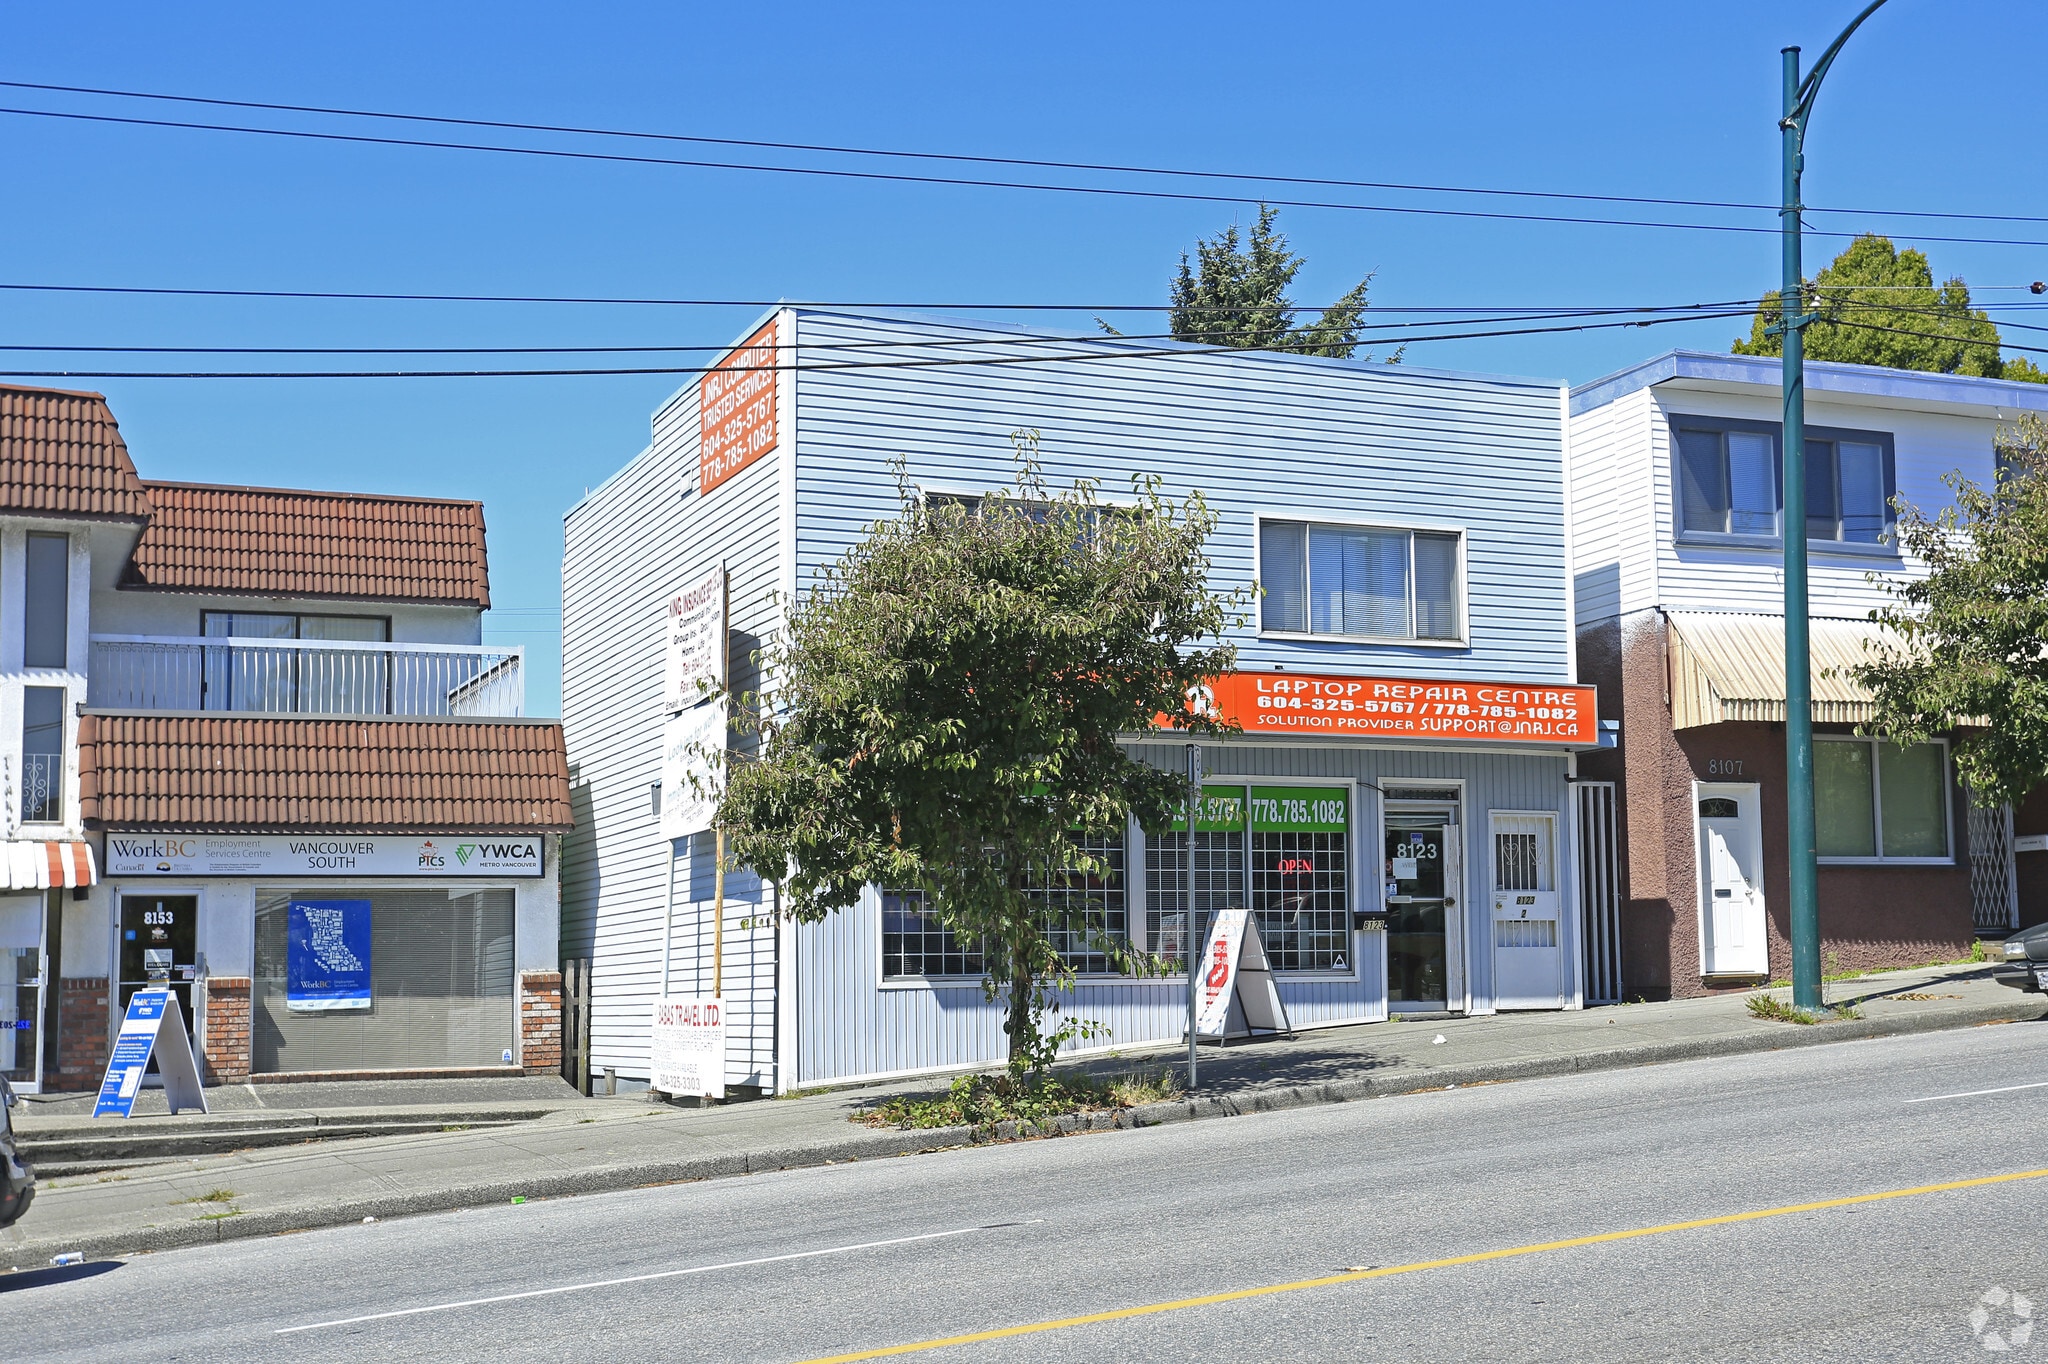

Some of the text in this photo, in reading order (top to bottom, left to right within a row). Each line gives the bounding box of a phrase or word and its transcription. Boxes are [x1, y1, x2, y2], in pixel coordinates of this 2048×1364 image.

[703, 332, 773, 408] JNRJ COMPUTER
[703, 361, 772, 432] TRUSTED SERVICES
[703, 391, 772, 460] 604-325-5767
[703, 420, 773, 486] 778-785-1082
[1257, 679, 1577, 706] LAPTOP REPAIR CENTRE
[1257, 696, 1415, 714] 604-325-5767
[1432, 703, 1578, 720] 778-785-1082
[1257, 714, 1578, 736] SOLUTION PROVIDER SUPPORT@JNRJ.CA
[1709, 759, 1743, 775] 8107
[1252, 799, 1345, 824] 778.785.1082
[112, 839, 196, 858] WorkBC
[205, 839, 261, 849] Employment
[289, 842, 374, 854] VANCOUVER
[478, 844, 536, 858] YWCA
[1397, 843, 1437, 859] 8123
[205, 849, 271, 858] Services Centre
[419, 856, 445, 867] PICS
[308, 856, 356, 868] SOUTH
[1278, 859, 1312, 875] OPEN
[1516, 896, 1536, 905] 8123
[144, 911, 174, 924] 8153
[1363, 921, 1385, 930] 8123
[300, 980, 331, 989] WorkBC
[675, 1004, 701, 1027] TRAVEL
[703, 1004, 721, 1027] LTD.
